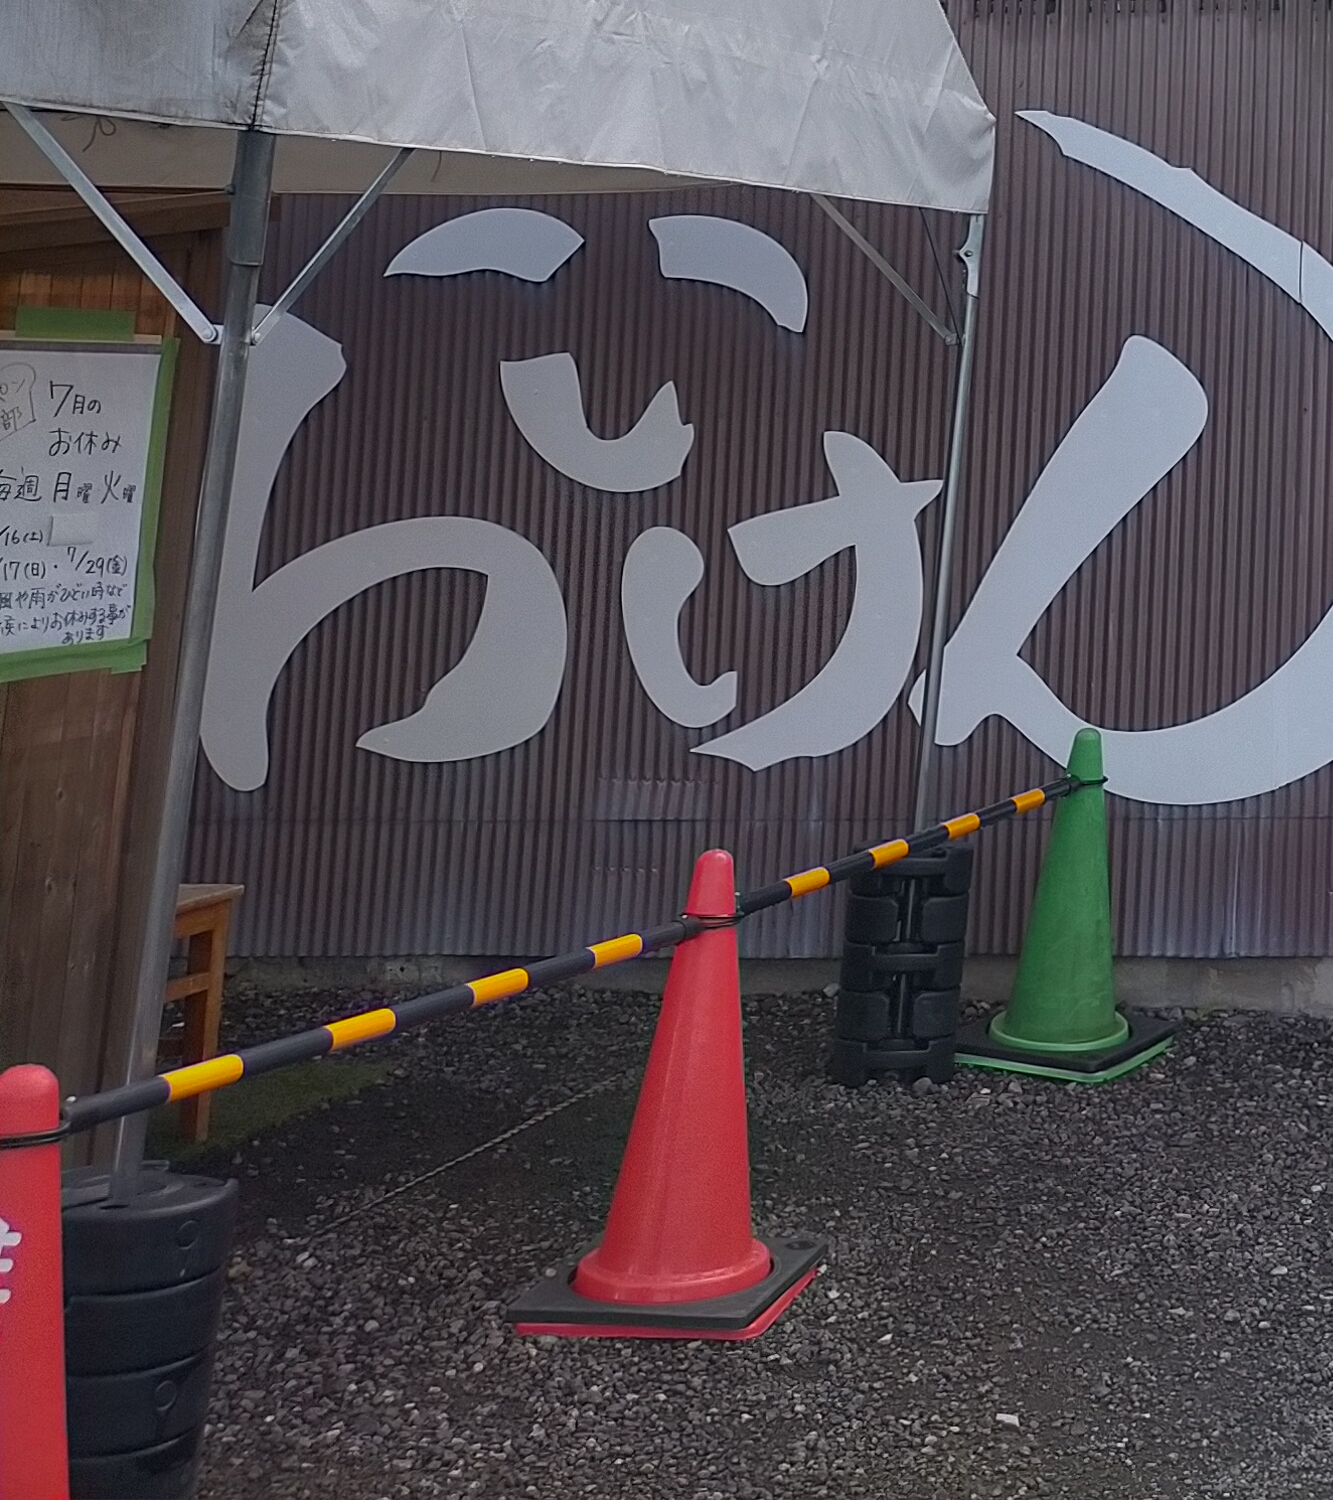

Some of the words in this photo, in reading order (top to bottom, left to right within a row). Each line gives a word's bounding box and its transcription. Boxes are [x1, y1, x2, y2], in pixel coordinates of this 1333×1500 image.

[49, 380, 102, 418] 7月の
[48, 427, 122, 457] お休み
